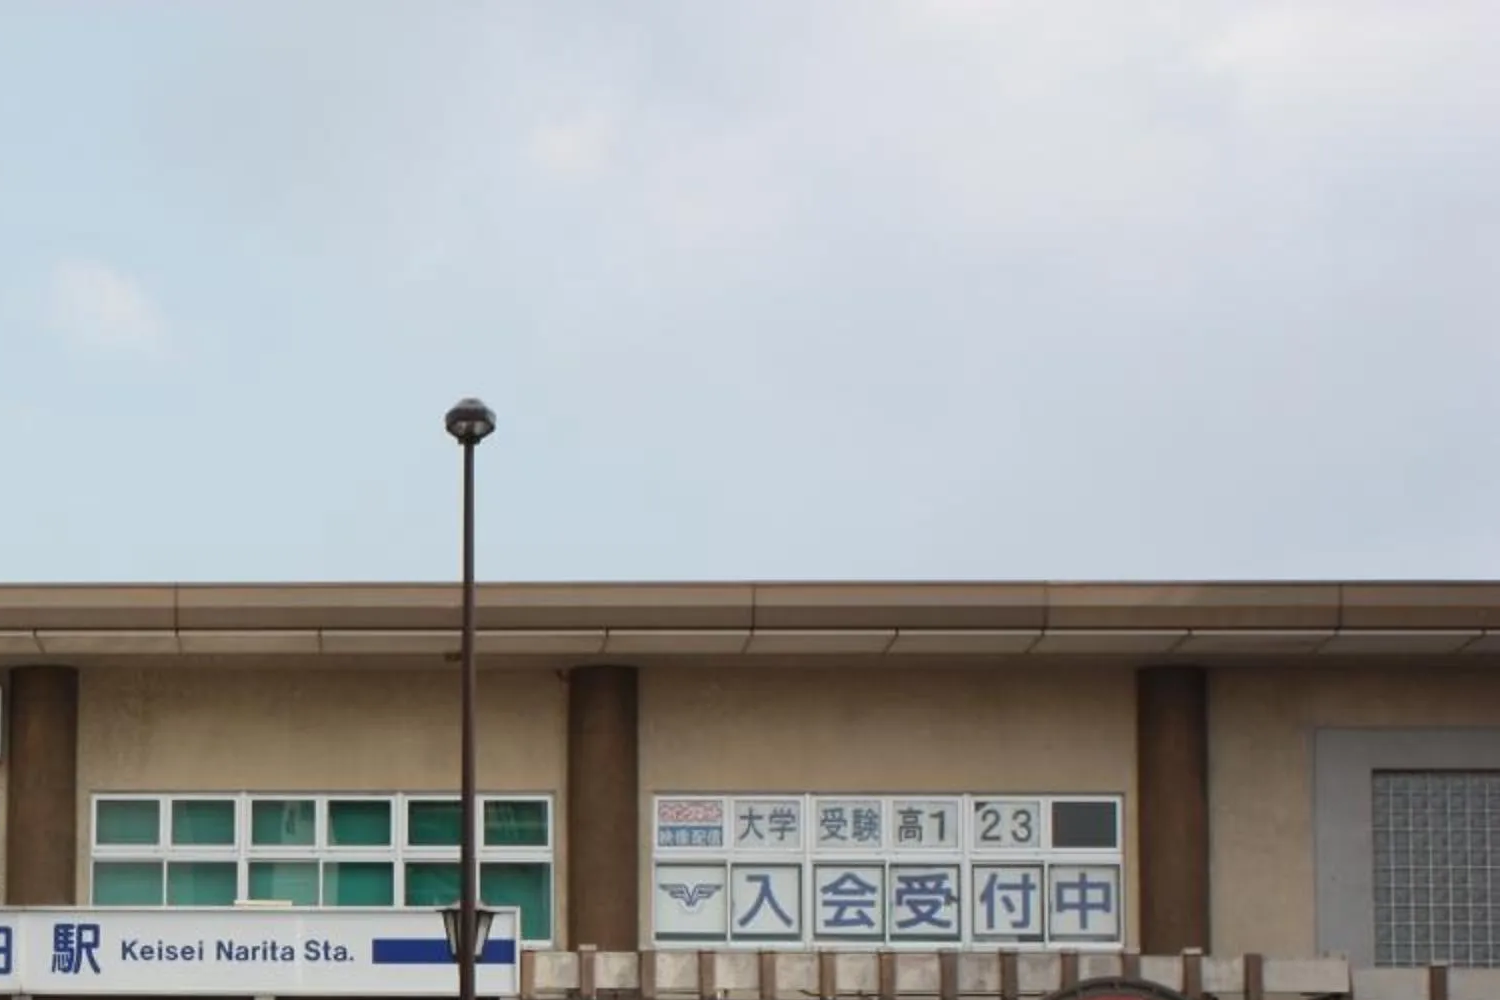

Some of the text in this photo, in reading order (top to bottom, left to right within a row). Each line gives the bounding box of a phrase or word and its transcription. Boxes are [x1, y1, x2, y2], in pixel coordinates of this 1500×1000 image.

[738, 872, 1112, 930] 入会受付中
[121, 940, 355, 962] Keisei Narita Sta.
